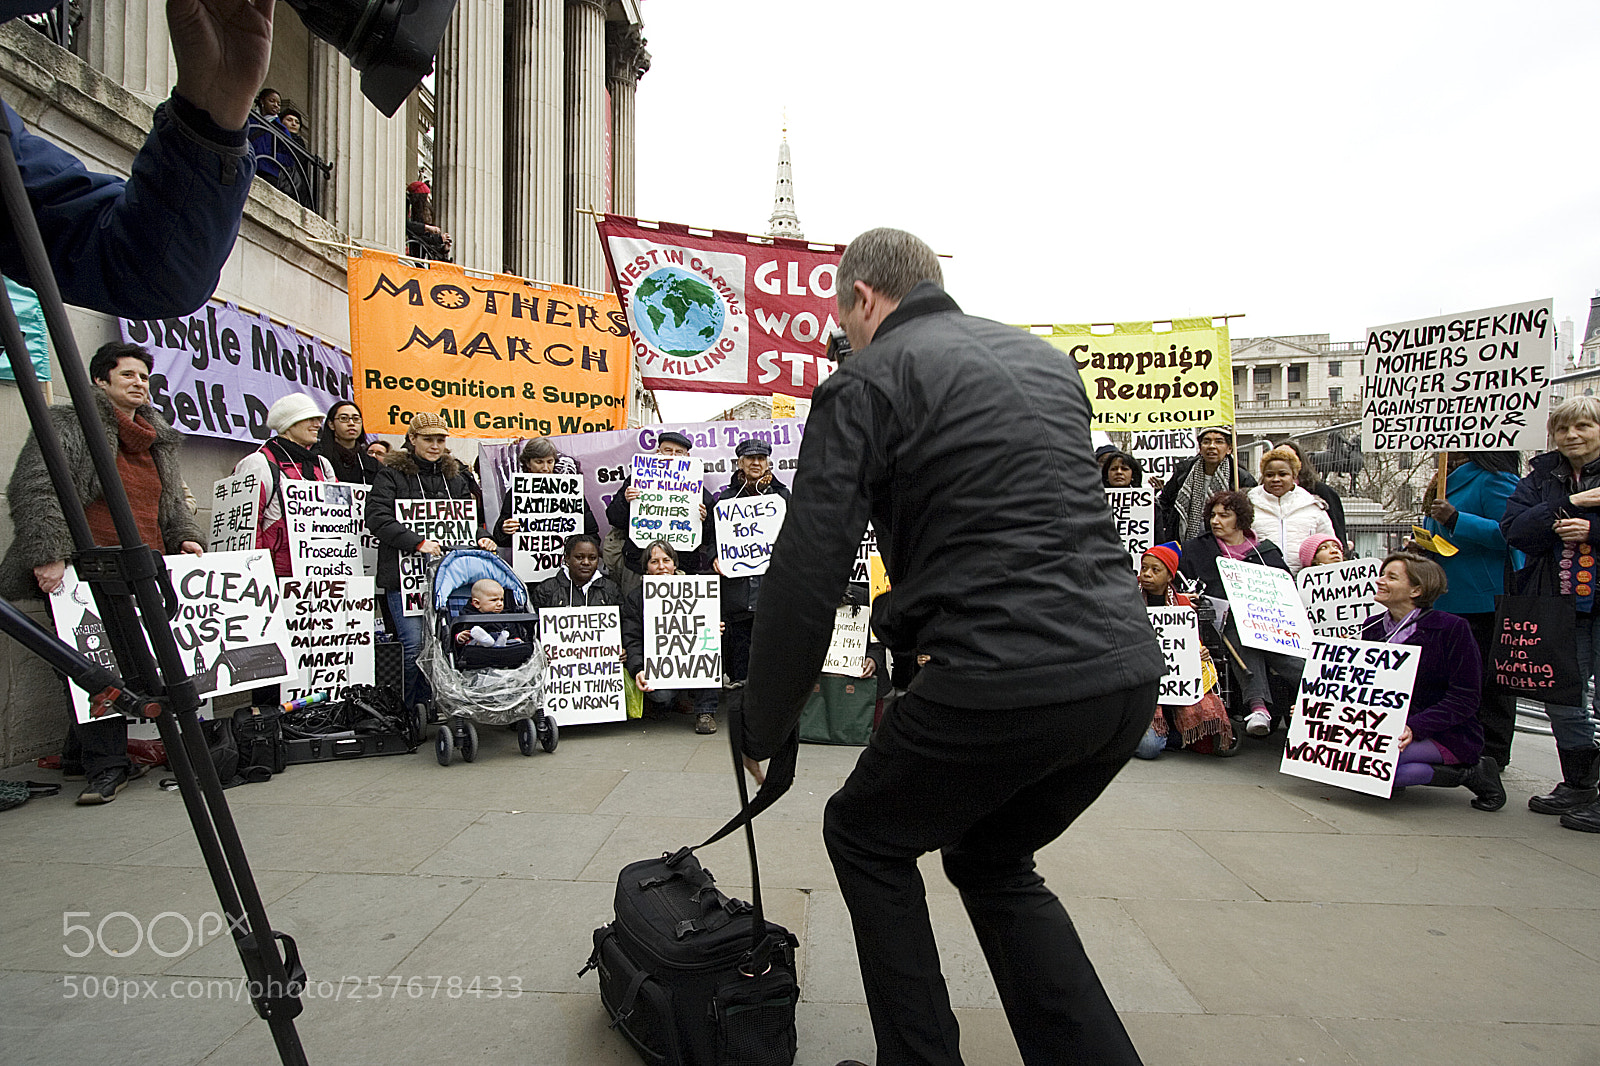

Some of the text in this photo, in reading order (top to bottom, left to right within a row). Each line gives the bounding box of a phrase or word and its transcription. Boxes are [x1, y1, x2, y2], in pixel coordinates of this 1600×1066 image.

[663, 249, 684, 266] IN
[690, 257, 742, 315] CARING
[363, 272, 629, 337] MOTHERS
[1365, 307, 1549, 356] ASYLUM SEEKING
[397, 325, 609, 374] MARCH
[662, 337, 735, 375] KILLING
[1069, 344, 1213, 375] Campaign
[1376, 341, 1519, 375] MOTHERS ON
[365, 369, 626, 409] Recognition & Support
[1094, 376, 1219, 403] Reunion
[1364, 366, 1550, 398] HUNGER STRIKE,
[1364, 391, 1541, 418] AGAINST DETENTION
[473, 411, 552, 436] Caring
[558, 416, 615, 434] Work
[1147, 409, 1215, 424] GROUP
[1372, 411, 1527, 433] DESTITUTION &
[1132, 432, 1196, 450] MOTHERS
[1374, 430, 1520, 450] DEPORTATION
[634, 455, 691, 471] INVEST IN
[597, 466, 625, 484] Sri
[636, 468, 686, 482] CARING,
[285, 484, 325, 503] Gail
[513, 476, 580, 495] ELEANOR
[633, 479, 655, 489] NOT
[657, 480, 703, 494] KILLING!
[287, 500, 352, 518] Sherwood
[513, 495, 584, 515] RATHBONE
[669, 494, 690, 504] FOR
[398, 500, 475, 521] WELFARE
[638, 503, 689, 517] MOTHERS
[716, 501, 777, 522] WAGES
[293, 518, 306, 533] is
[515, 516, 577, 533] MOTHERS
[631, 516, 692, 532] GOOD FOR
[732, 522, 764, 537] FOR
[298, 540, 358, 558] Prosecute
[517, 535, 564, 552] NEED
[305, 560, 354, 577] rapists
[531, 552, 565, 572] YOU
[402, 576, 425, 591] OF
[1222, 570, 1243, 583] WE
[1303, 563, 1378, 589] ATT VARA
[180, 569, 279, 613] CLEAN
[283, 580, 346, 600] RAPE
[645, 581, 718, 599] DOUBLE
[1312, 581, 1377, 604] MAMMA
[295, 598, 374, 615] SURVIVORS
[661, 599, 698, 615] DAY
[1306, 603, 1375, 624] ÄR ETT
[543, 613, 617, 634] MOTHERS
[654, 615, 705, 635] HALF
[1147, 610, 1196, 629] NDING
[291, 631, 371, 648] DAUGHTERS
[560, 629, 605, 643] WANT
[655, 628, 719, 655] PAY £
[298, 651, 354, 670] MARCH
[545, 644, 620, 660] RECOGNITION
[1311, 642, 1411, 671] THEY SAY
[311, 669, 347, 686] FOR
[550, 661, 620, 679] NOT BLAME
[1320, 664, 1377, 686] WE'RE
[1494, 658, 1554, 679] Working
[543, 678, 623, 695] WHEN THINGS
[1301, 677, 1410, 710] WORKLESS
[547, 695, 619, 711] GO WRONG
[1302, 698, 1388, 731] WE SAY
[1305, 720, 1393, 754] THEY'RE
[1284, 738, 1393, 782] WORTHLESS
